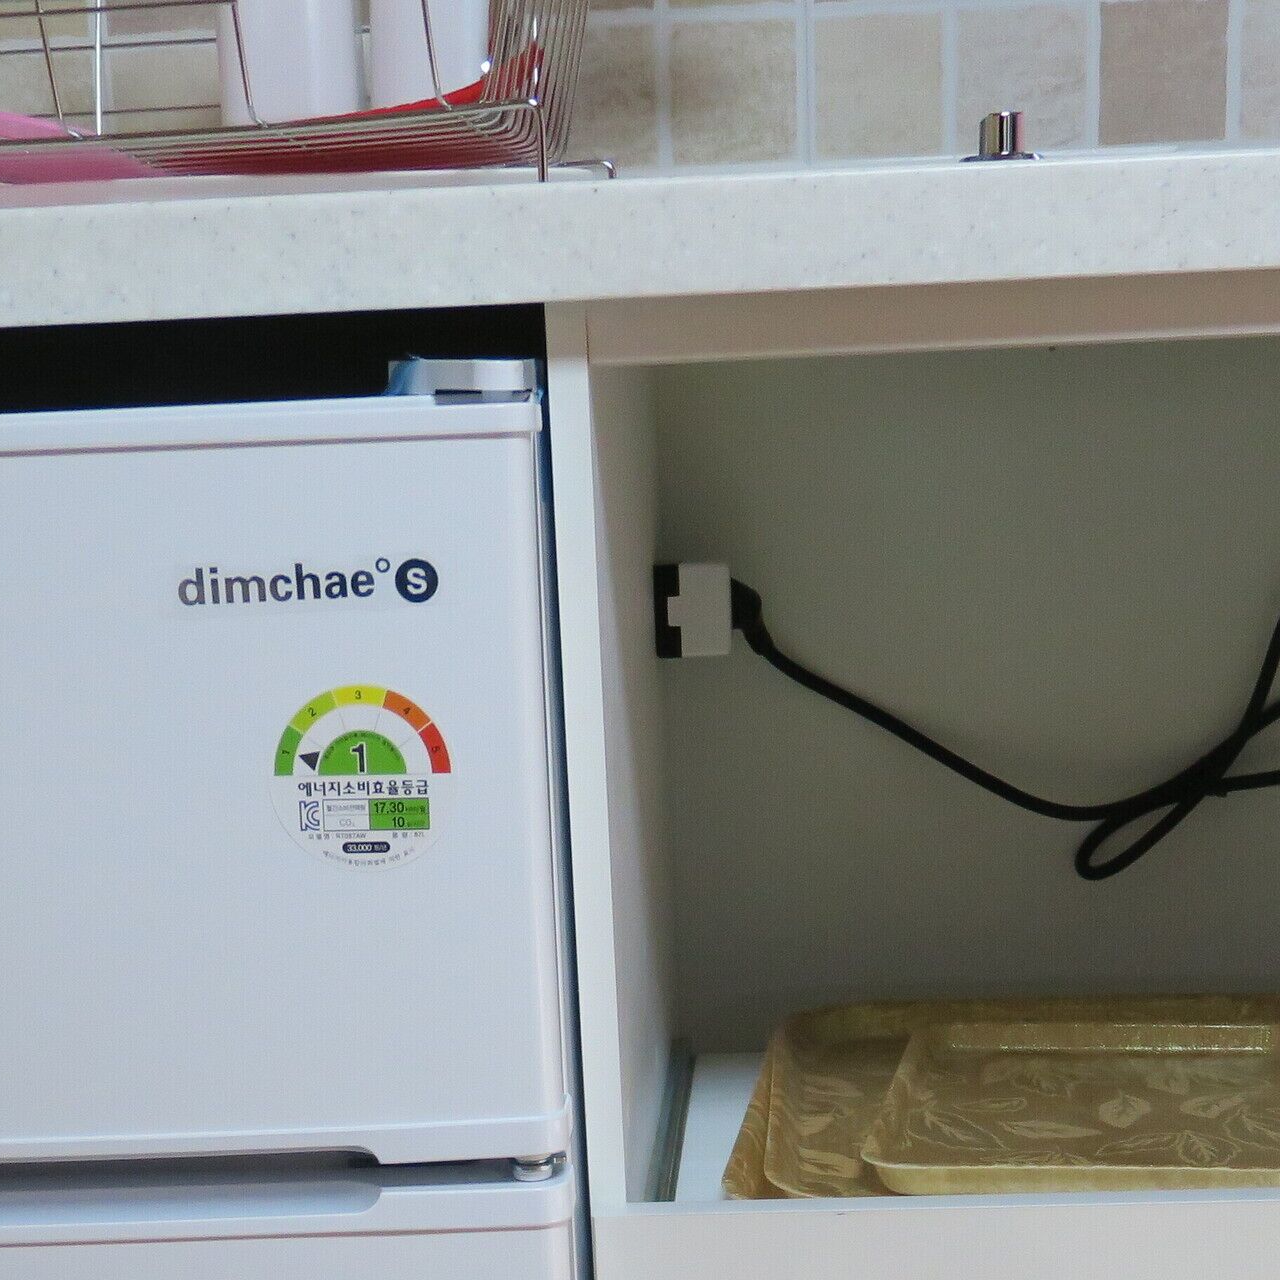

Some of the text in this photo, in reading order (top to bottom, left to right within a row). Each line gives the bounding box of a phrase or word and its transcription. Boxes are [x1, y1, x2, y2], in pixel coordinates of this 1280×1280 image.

[354, 689, 362, 700] 3
[309, 707, 317, 717] 2
[403, 706, 411, 715] 4
[352, 743, 366, 774] 1
[298, 780, 429, 797] 에너지소비효율등급
[374, 802, 404, 814] 17.30
[392, 817, 405, 828] 10
